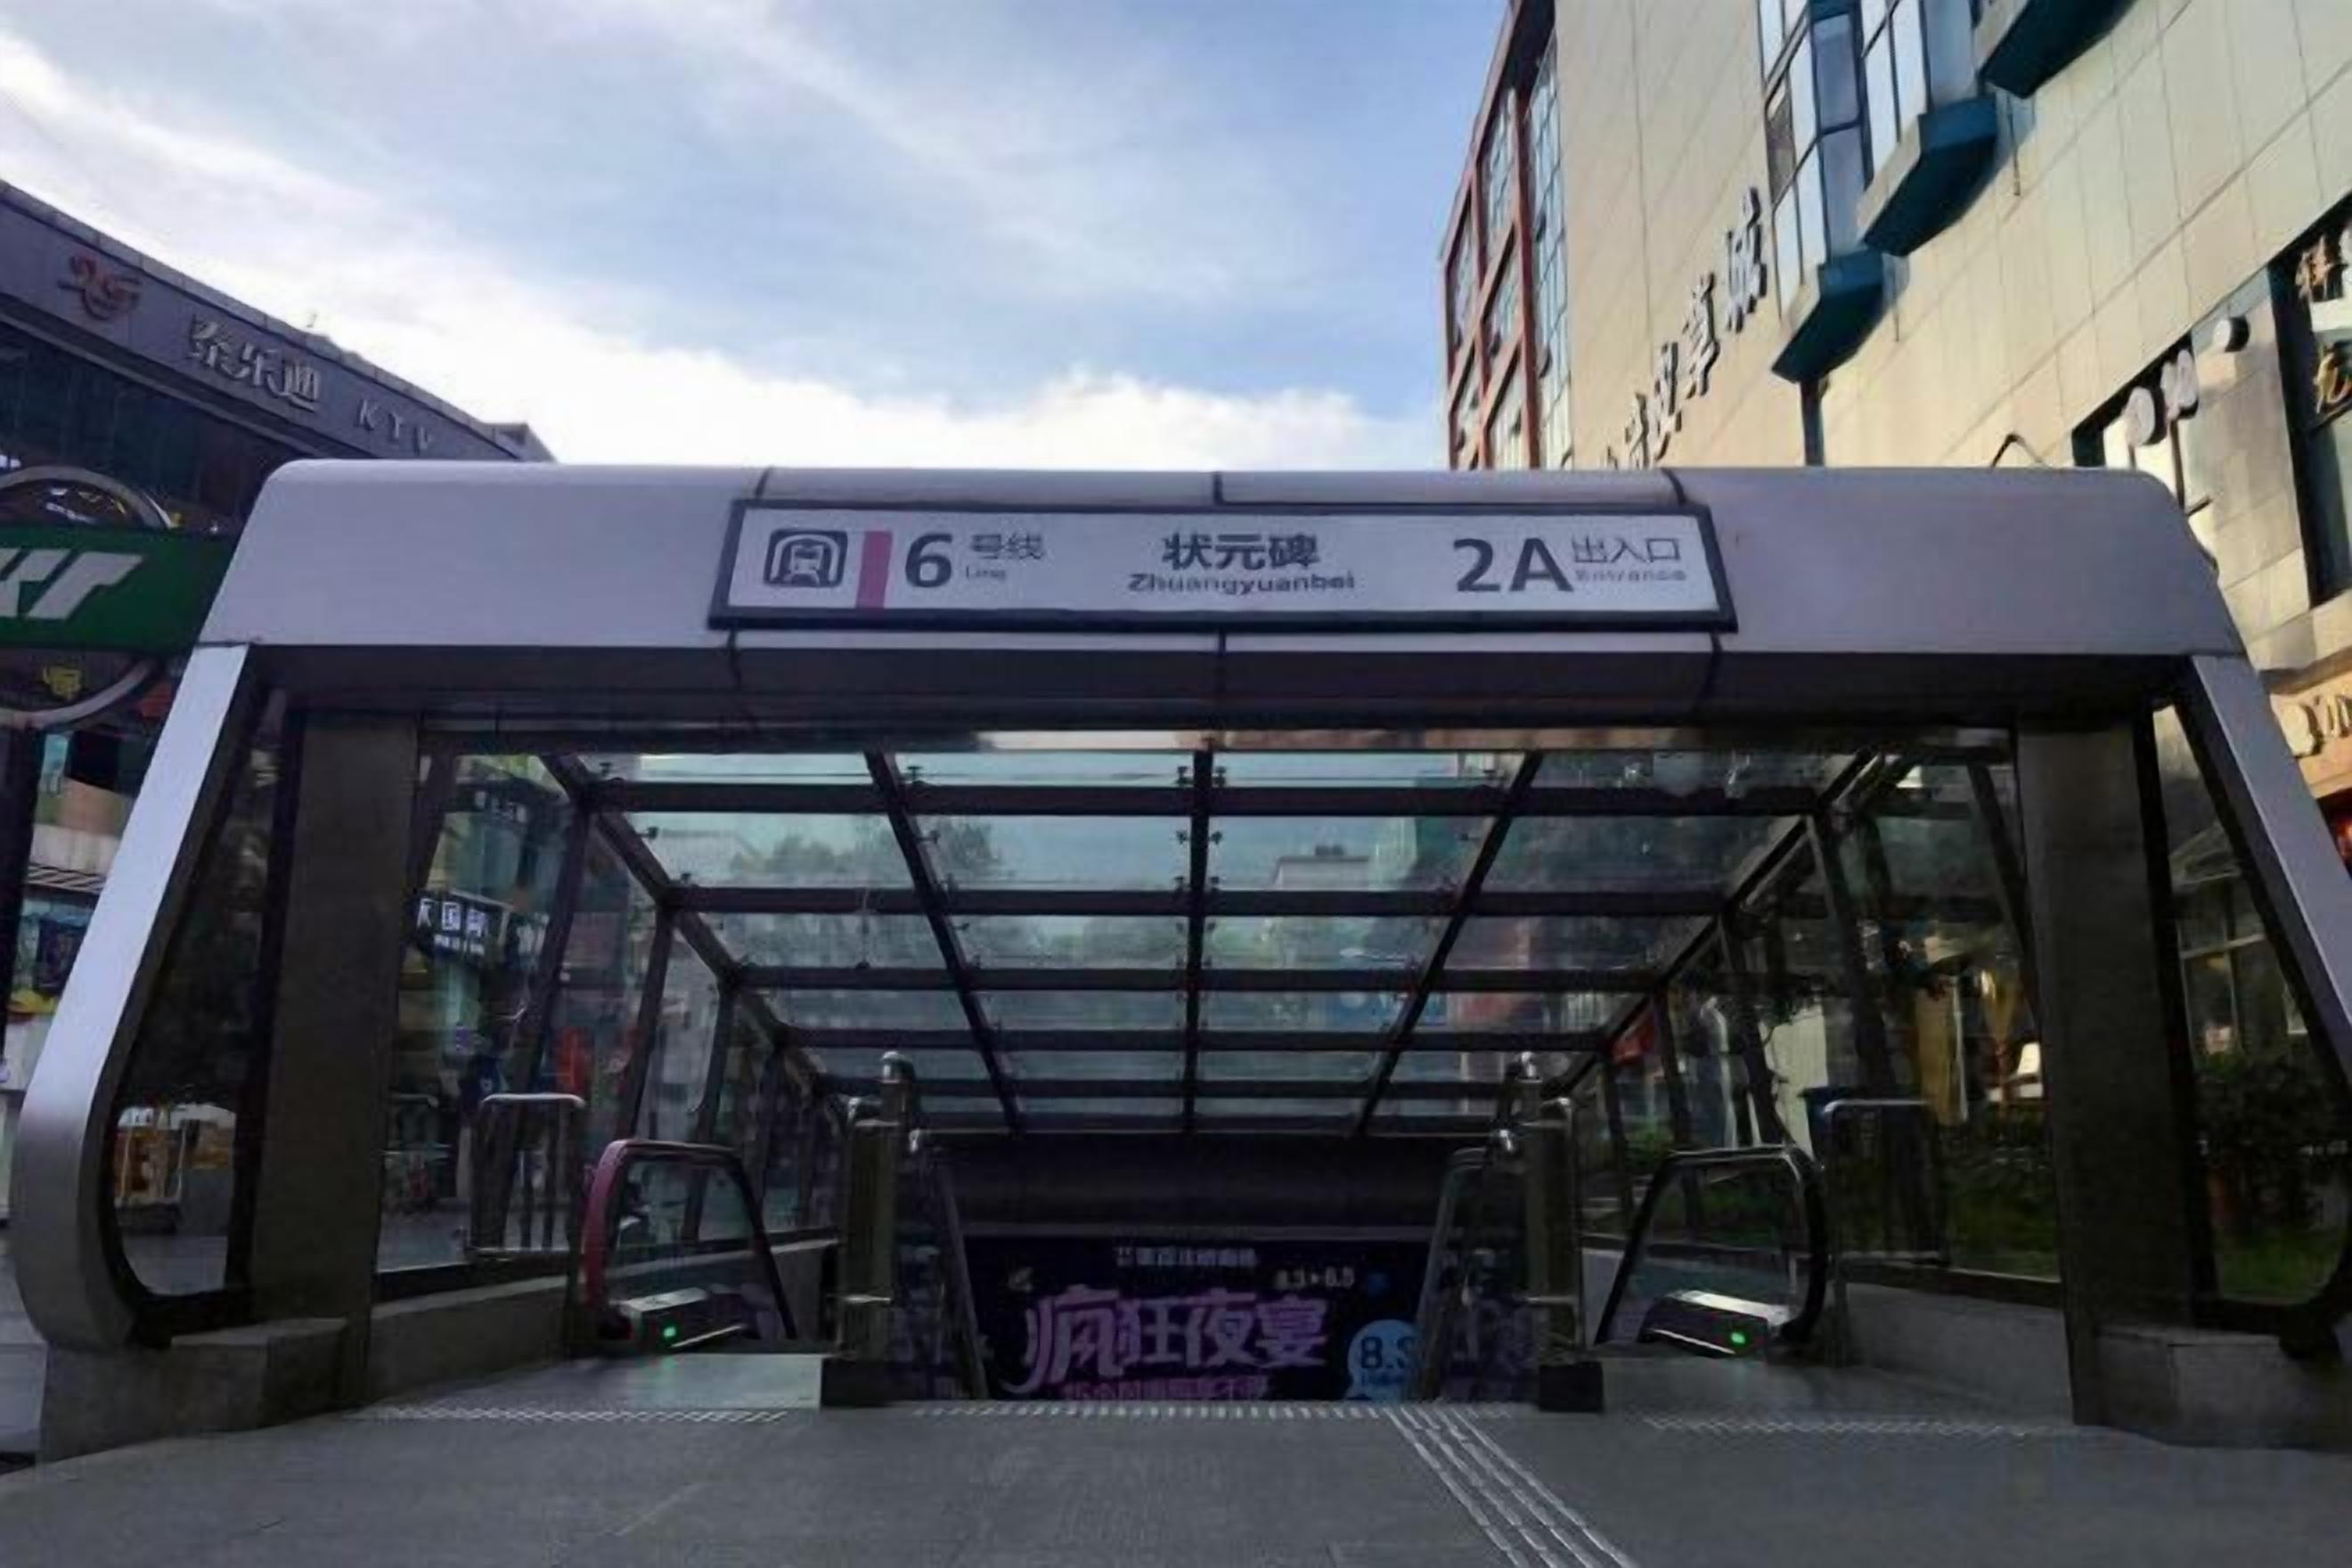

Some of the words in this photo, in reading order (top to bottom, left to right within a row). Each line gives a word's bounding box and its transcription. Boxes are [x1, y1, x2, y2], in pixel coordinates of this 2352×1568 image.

[905, 533, 951, 588] 6
[969, 532, 1044, 560] 号线
[1161, 532, 1320, 570] 状元碑
[1452, 536, 1573, 592] 2A
[1571, 534, 1682, 564] 出入口
[1128, 570, 1356, 595] Zhuangyuanbei
[998, 1283, 1327, 1394] 疯狂夜宴
